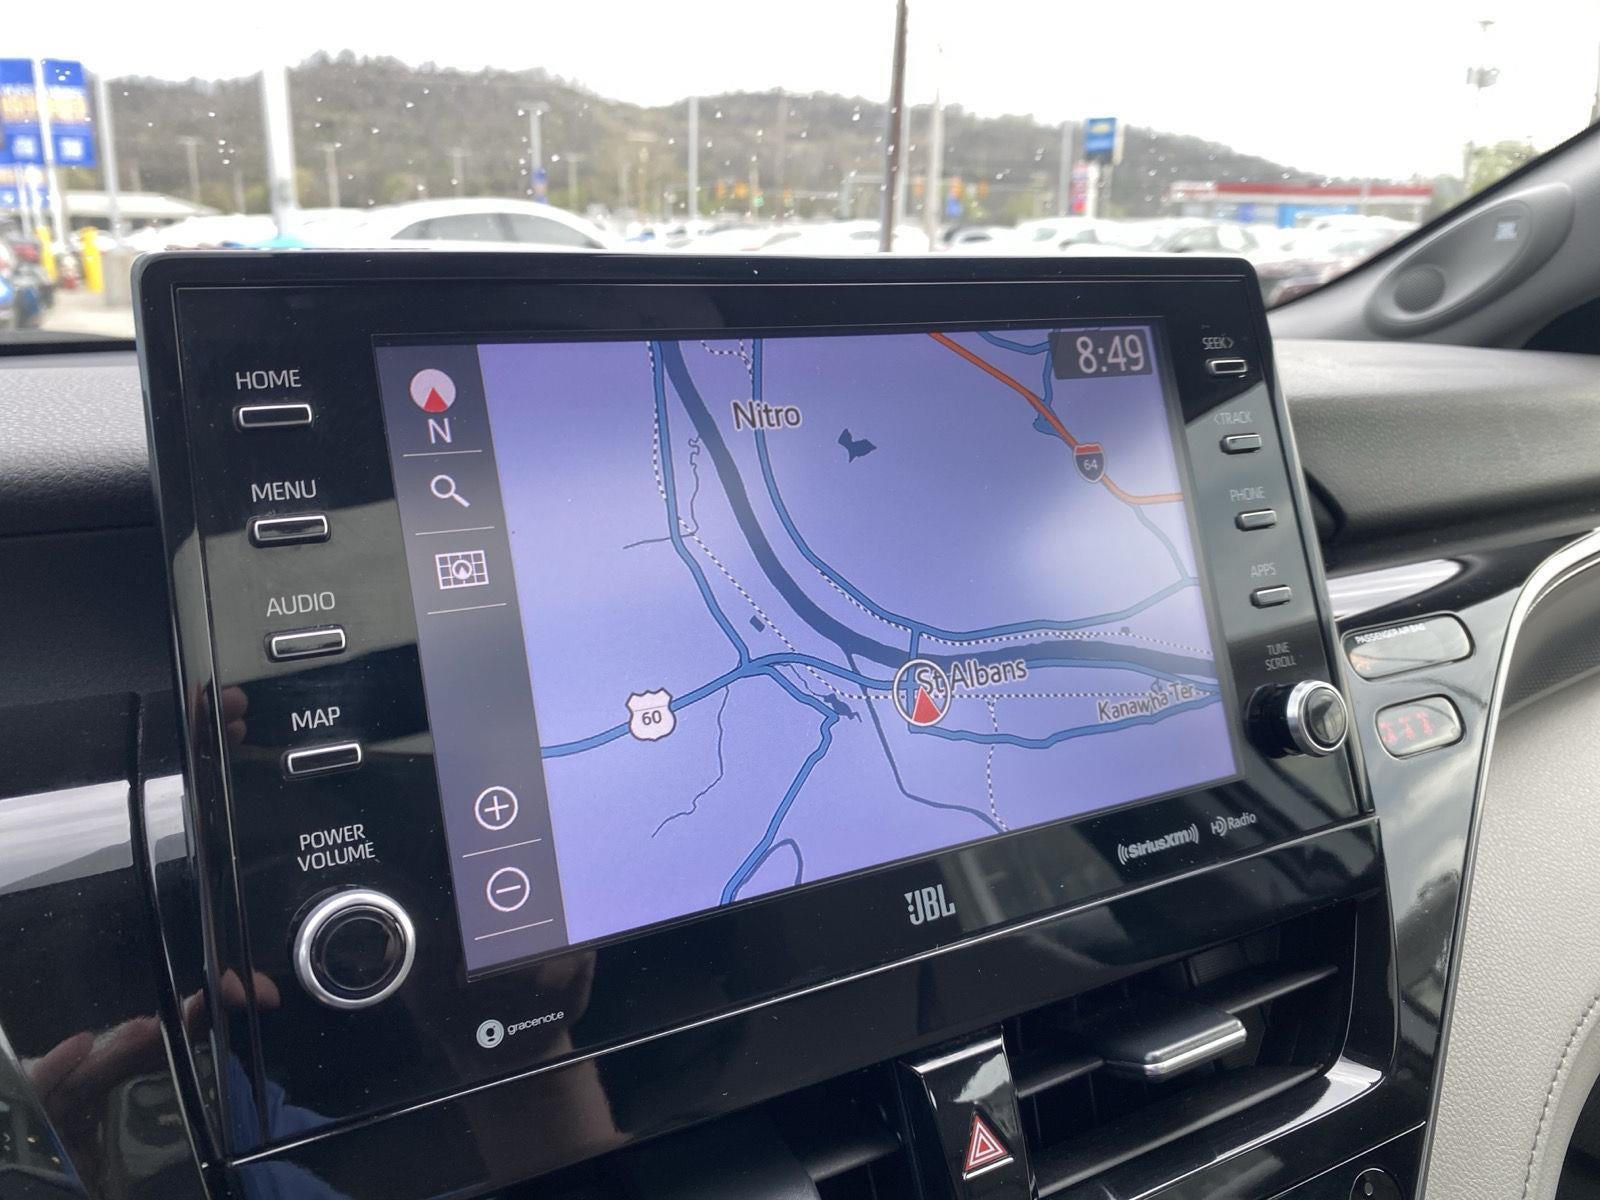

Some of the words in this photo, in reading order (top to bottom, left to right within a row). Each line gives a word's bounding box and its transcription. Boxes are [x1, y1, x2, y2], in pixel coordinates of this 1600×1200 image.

[1075, 333, 1145, 375] 8:49
[235, 368, 302, 390] HOME
[732, 400, 802, 431] Nitro
[427, 417, 452, 444] N
[1082, 458, 1099, 471] 64
[250, 479, 317, 503] MENU
[1229, 485, 1266, 503] PHONE
[1250, 561, 1277, 578] APPS
[266, 591, 336, 618] AUDIO
[1264, 655, 1298, 671] SCROLL
[916, 668, 946, 695] St
[951, 660, 1028, 691] Albans
[1098, 692, 1169, 721] Kanawha
[1168, 682, 1194, 702] Ter
[291, 706, 341, 731] MAP
[641, 710, 663, 726] 60
[1227, 812, 1257, 829] Radio
[299, 823, 366, 851] POWER
[297, 842, 376, 872] VOLUME
[905, 883, 956, 925] JBL
[507, 1011, 565, 1036] gracenote
